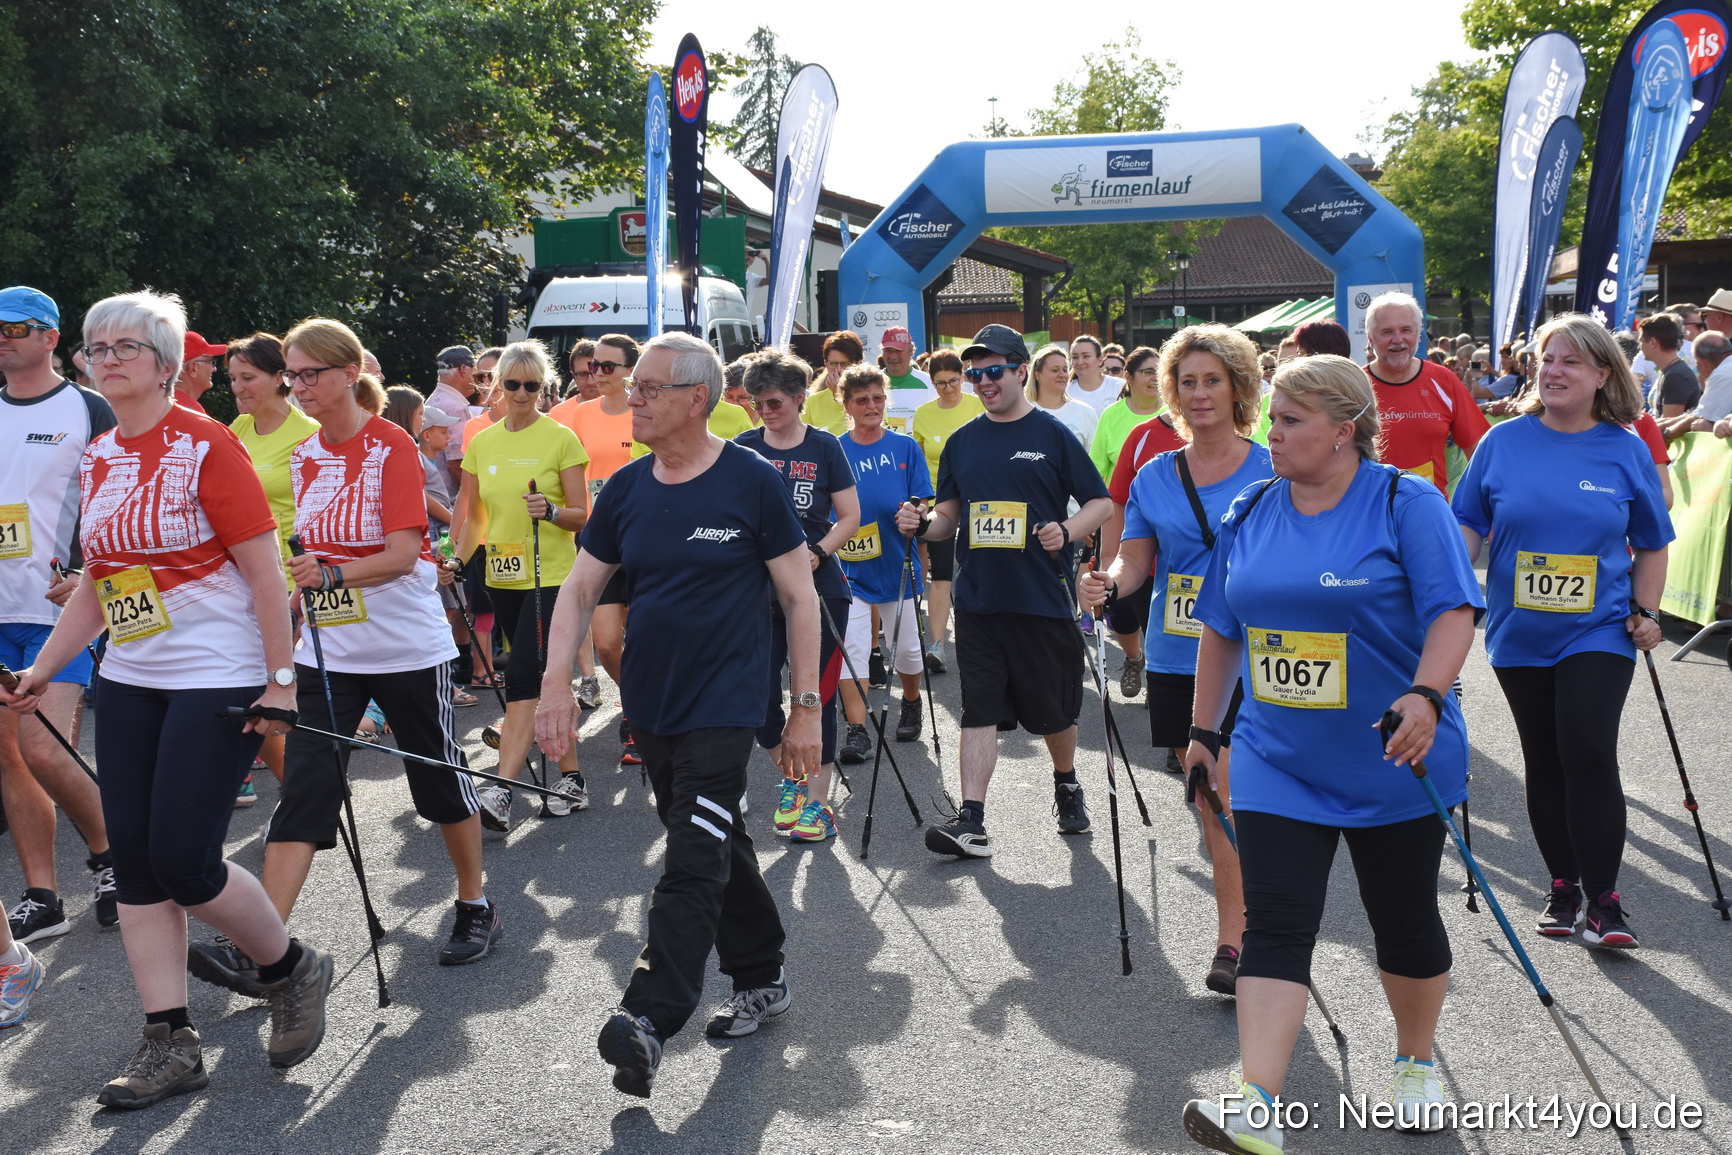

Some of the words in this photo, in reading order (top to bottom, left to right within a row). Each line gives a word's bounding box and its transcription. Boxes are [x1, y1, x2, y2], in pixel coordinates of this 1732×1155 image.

[677, 66, 703, 107] Hervis
[1523, 58, 1561, 161] Fischer
[794, 89, 819, 186] Fischer
[805, 101, 825, 180] AUTOMOBILE
[1116, 160, 1151, 168] Fischer
[1546, 139, 1567, 204] Fischer
[1554, 149, 1569, 202] AUTOMOBILE
[1091, 175, 1193, 198] firmenlauf
[1091, 197, 1132, 205] neumarkt
[1301, 204, 1316, 214] und
[1318, 202, 1333, 210] das
[899, 221, 952, 233] Fischer
[543, 303, 586, 313] abavent
[26, 433, 54, 441] swn
[789, 460, 818, 480] ME
[687, 527, 726, 540] JURA
[975, 517, 1016, 535] 1441
[490, 556, 520, 573] 1249
[1341, 578, 1370, 587] classic
[1525, 573, 1585, 597] 1072
[1529, 594, 1557, 602] Hofmann
[1558, 596, 1578, 604] Sylvia
[107, 591, 154, 626] 2234
[136, 617, 152, 626] Petra
[1260, 643, 1297, 654] firmenlauf
[1300, 651, 1318, 660] walk
[1260, 656, 1332, 687] 1067
[1272, 685, 1293, 694] Gauer
[1294, 687, 1317, 696] Lydia
